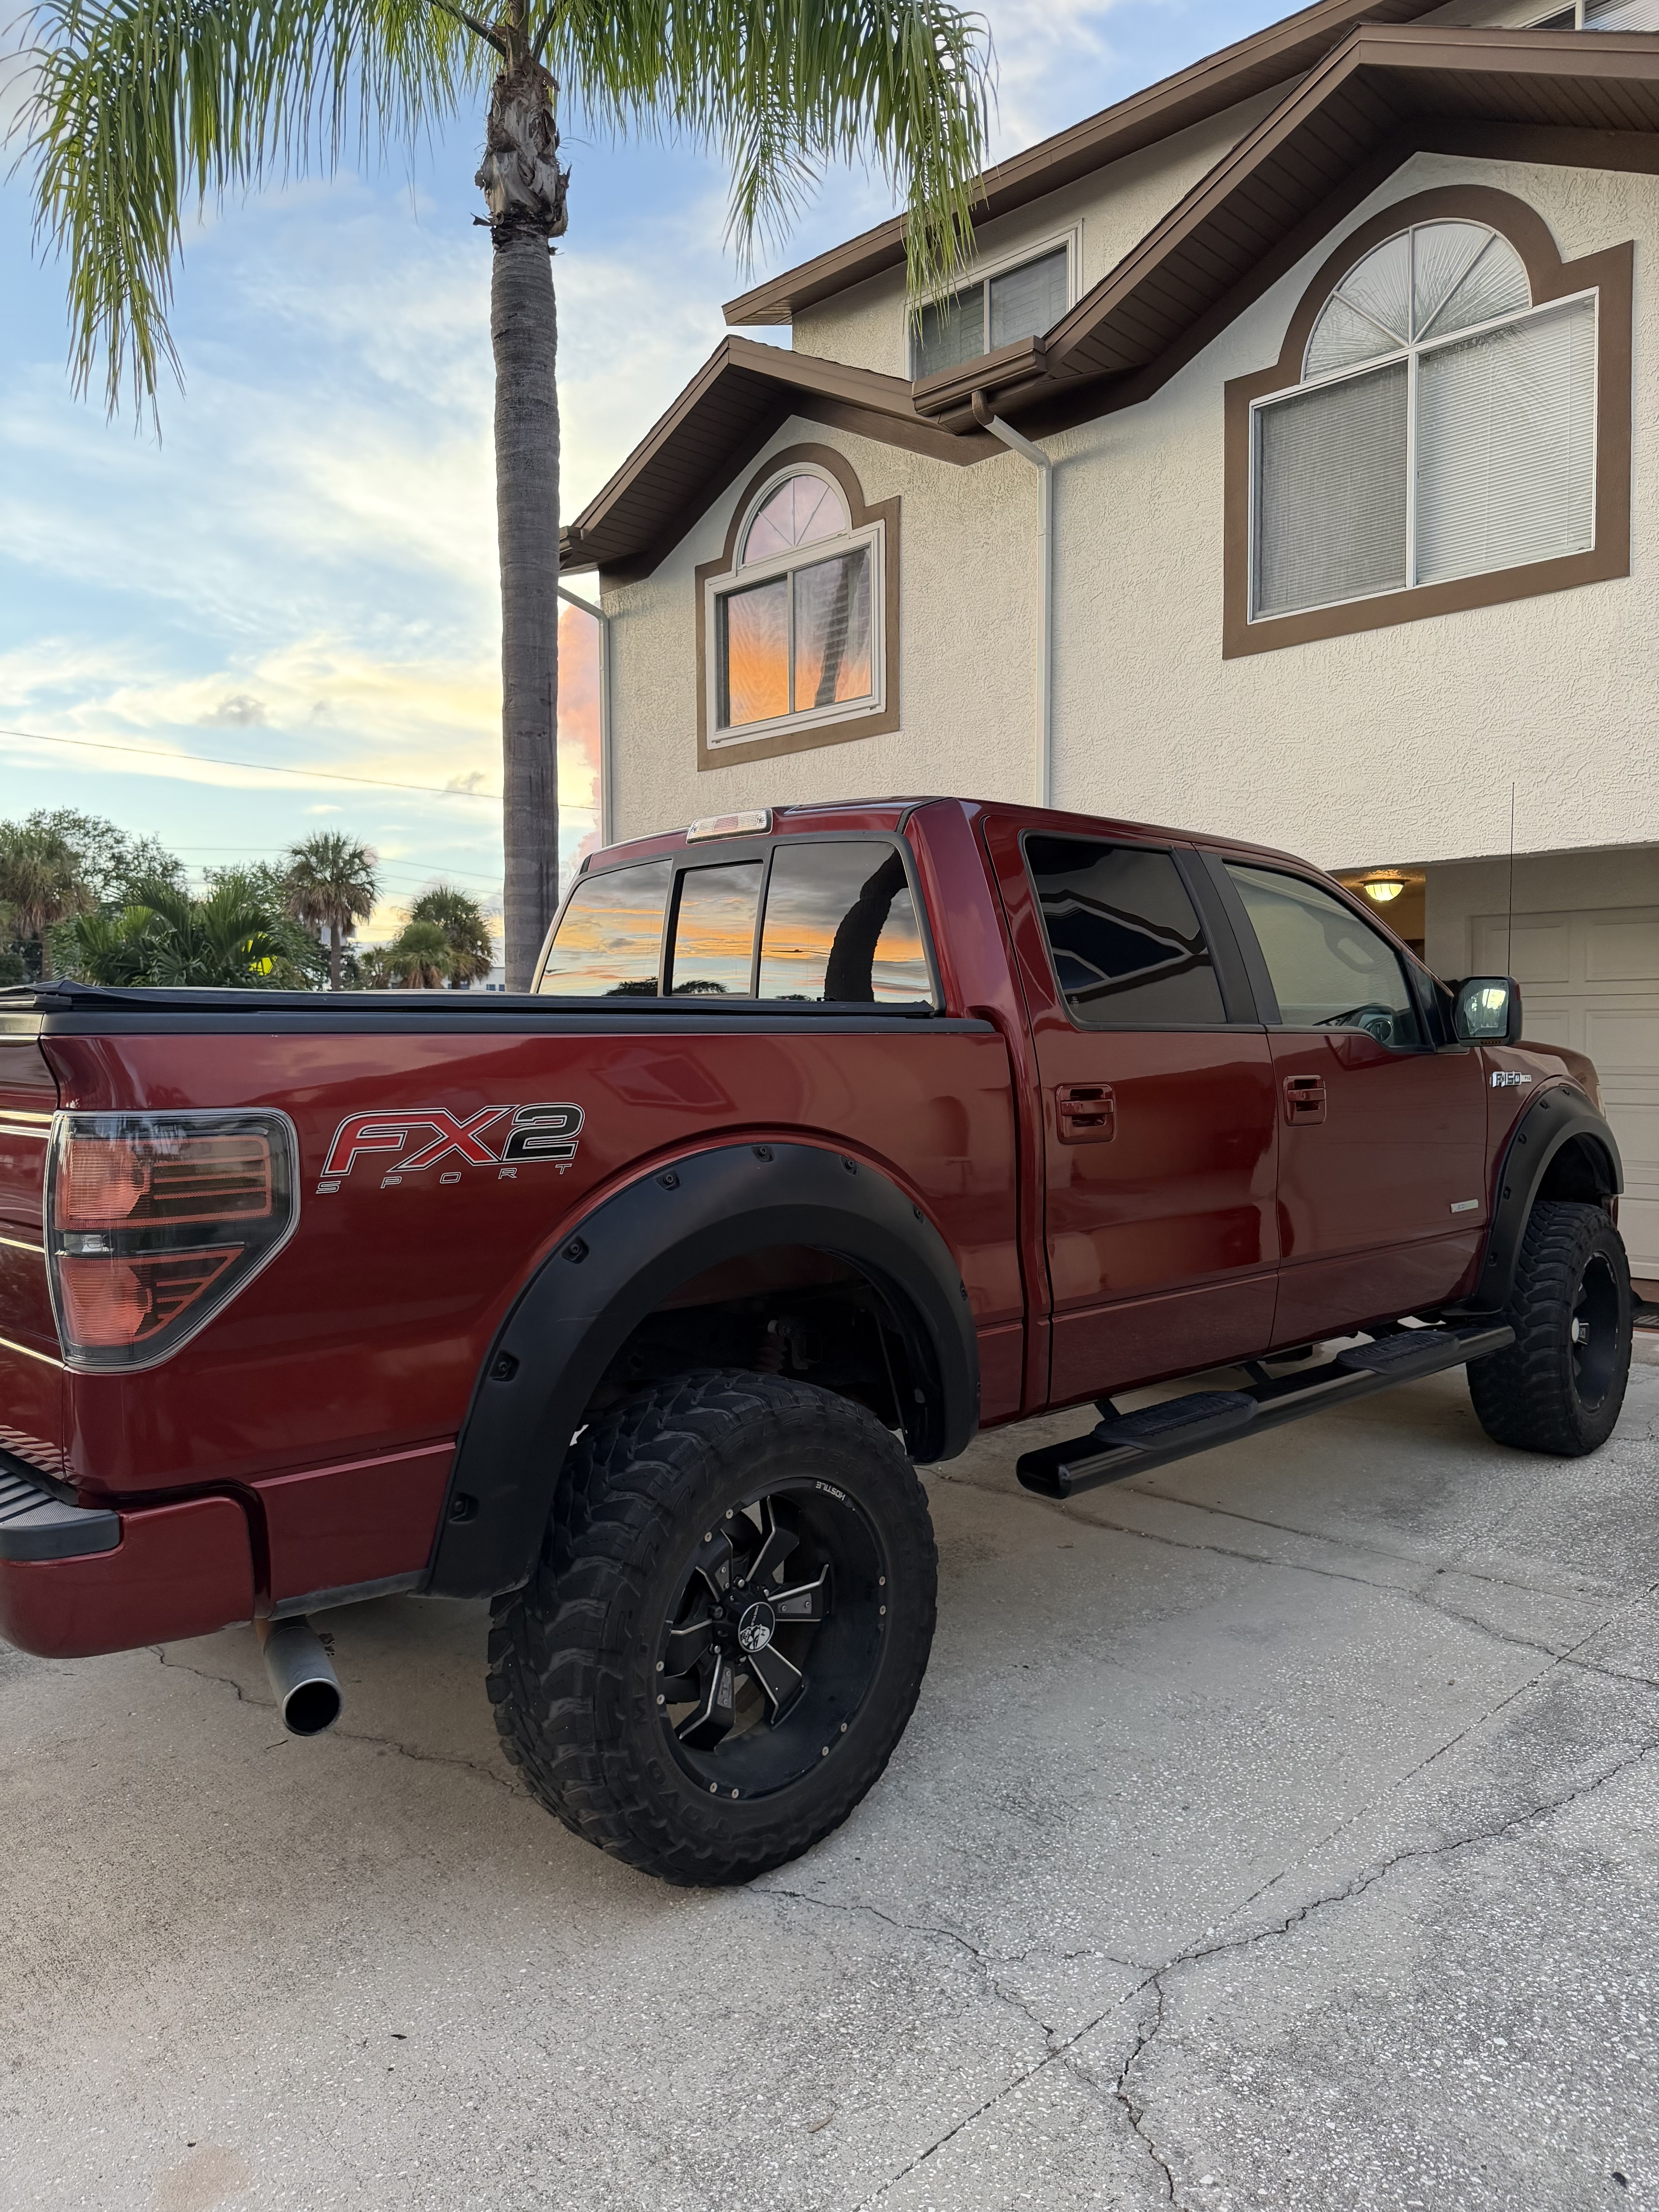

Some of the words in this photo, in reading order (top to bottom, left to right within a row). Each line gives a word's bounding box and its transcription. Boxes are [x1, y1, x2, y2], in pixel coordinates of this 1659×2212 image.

[320, 1103, 585, 1177] FX2
[316, 1163, 572, 1194] SPORT
[816, 1481, 846, 1501] HOSTILE
